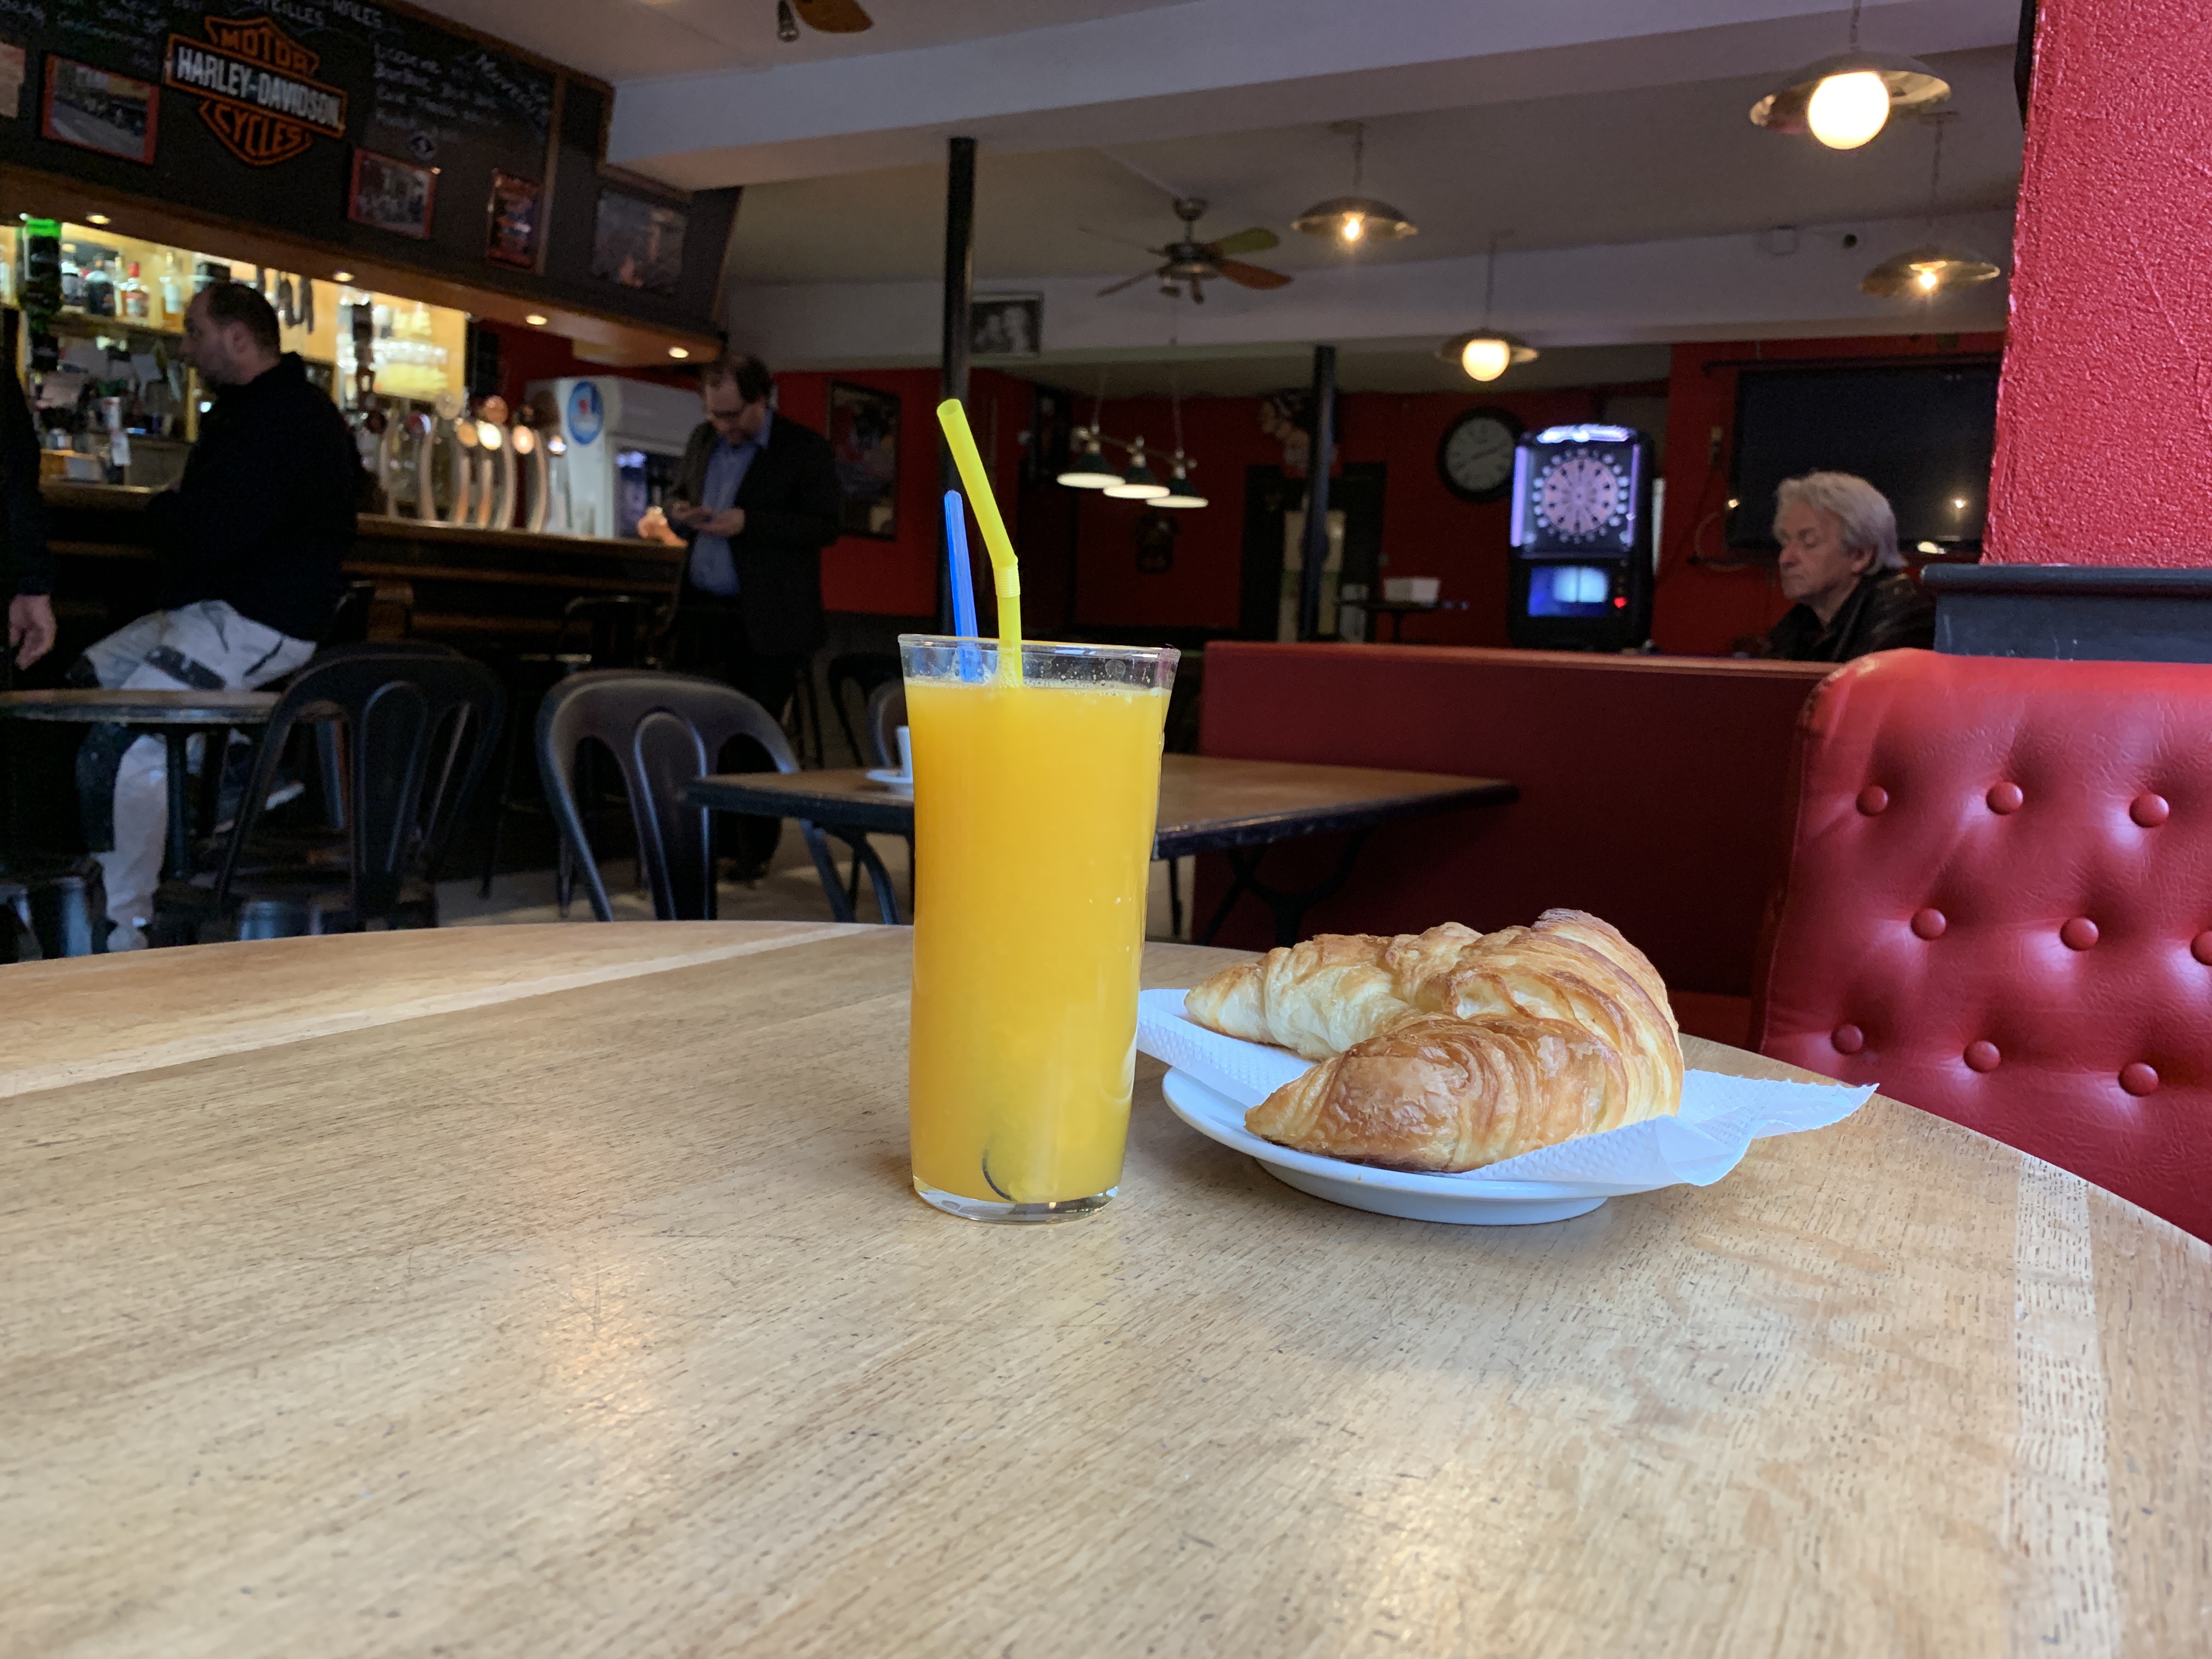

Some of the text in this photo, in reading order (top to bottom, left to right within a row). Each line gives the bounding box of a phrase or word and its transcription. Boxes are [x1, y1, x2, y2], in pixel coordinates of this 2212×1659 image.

[221, 28, 308, 77] MOTOR
[177, 46, 340, 129] HARLEY-DAVIDSON
[214, 104, 302, 156] CYCLES
